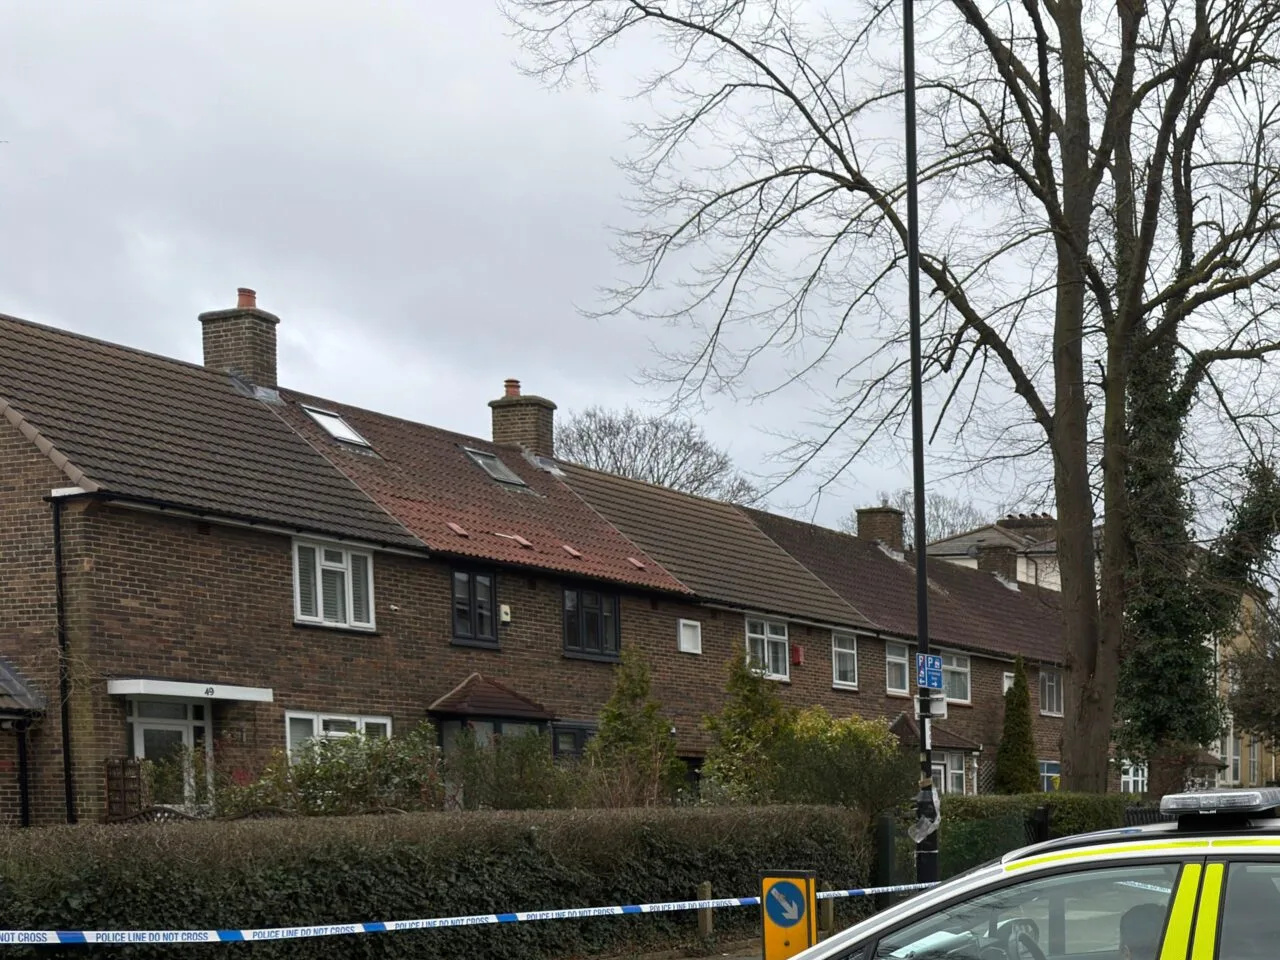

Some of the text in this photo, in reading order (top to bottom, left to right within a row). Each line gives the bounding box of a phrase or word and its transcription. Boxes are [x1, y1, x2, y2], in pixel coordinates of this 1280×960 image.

[17, 931, 48, 943] CROSS
[96, 931, 209, 943] POLICE LINE DO NOT CROSS
[252, 925, 356, 939] POLICE LINE DO NOT CROSS
